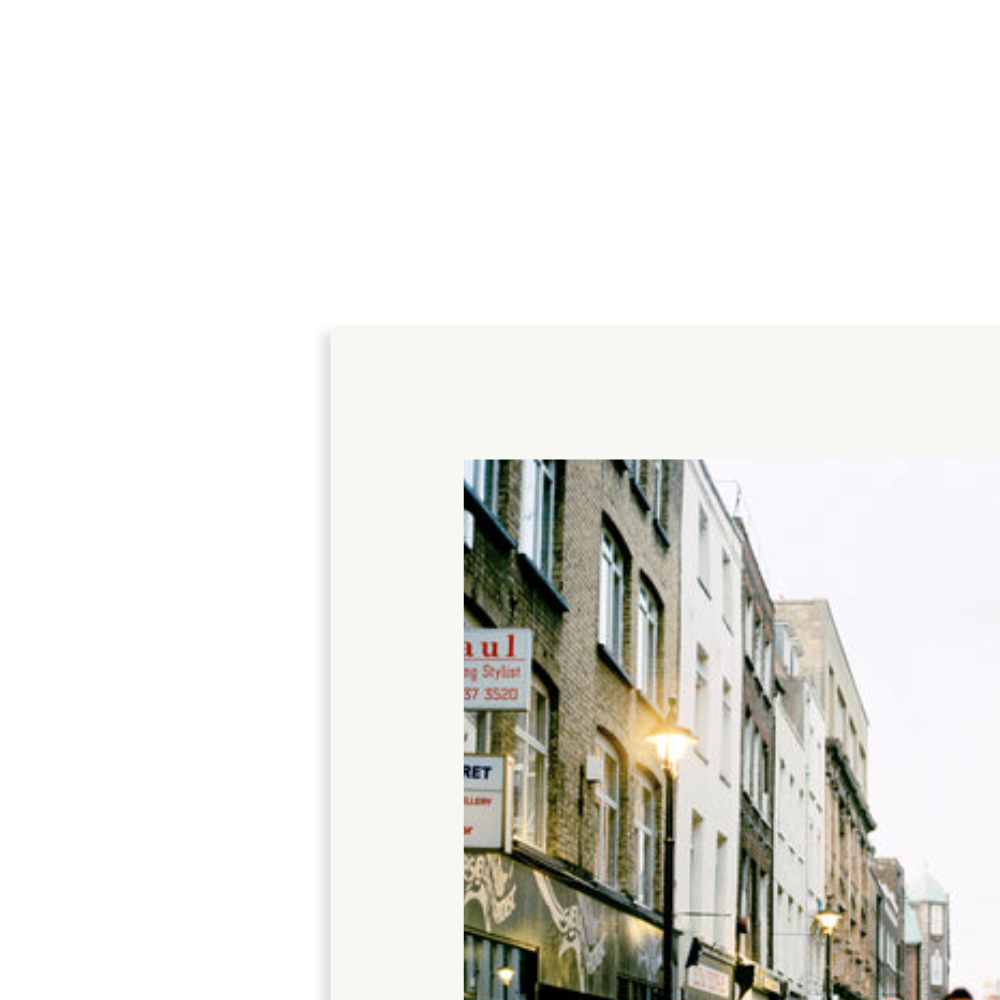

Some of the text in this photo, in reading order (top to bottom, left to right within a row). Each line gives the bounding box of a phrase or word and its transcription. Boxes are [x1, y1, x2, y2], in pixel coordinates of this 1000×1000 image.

[482, 663, 520, 681] Stylist
[483, 687, 518, 700] 3520
[464, 765, 493, 779] RET
